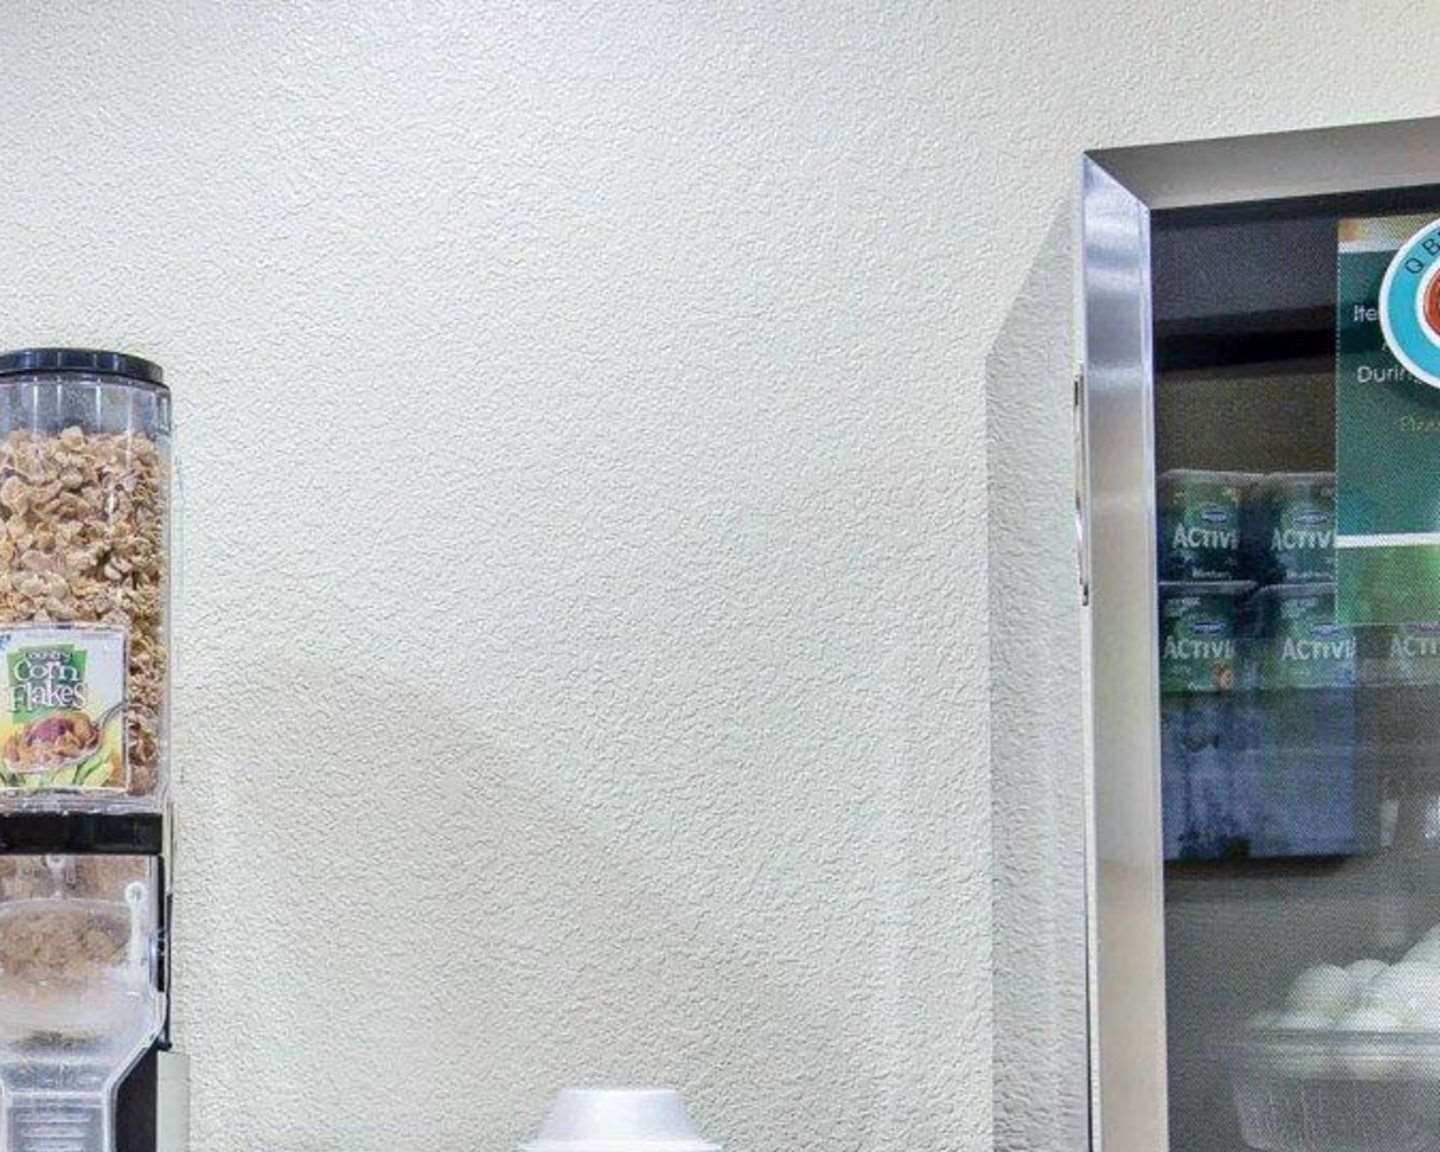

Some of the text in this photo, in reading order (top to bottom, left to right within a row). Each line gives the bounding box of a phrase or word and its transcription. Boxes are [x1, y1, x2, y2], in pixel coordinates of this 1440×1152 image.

[1353, 304, 1381, 322] Ite
[13, 657, 80, 682] Corn
[7, 679, 88, 713] Flakes
